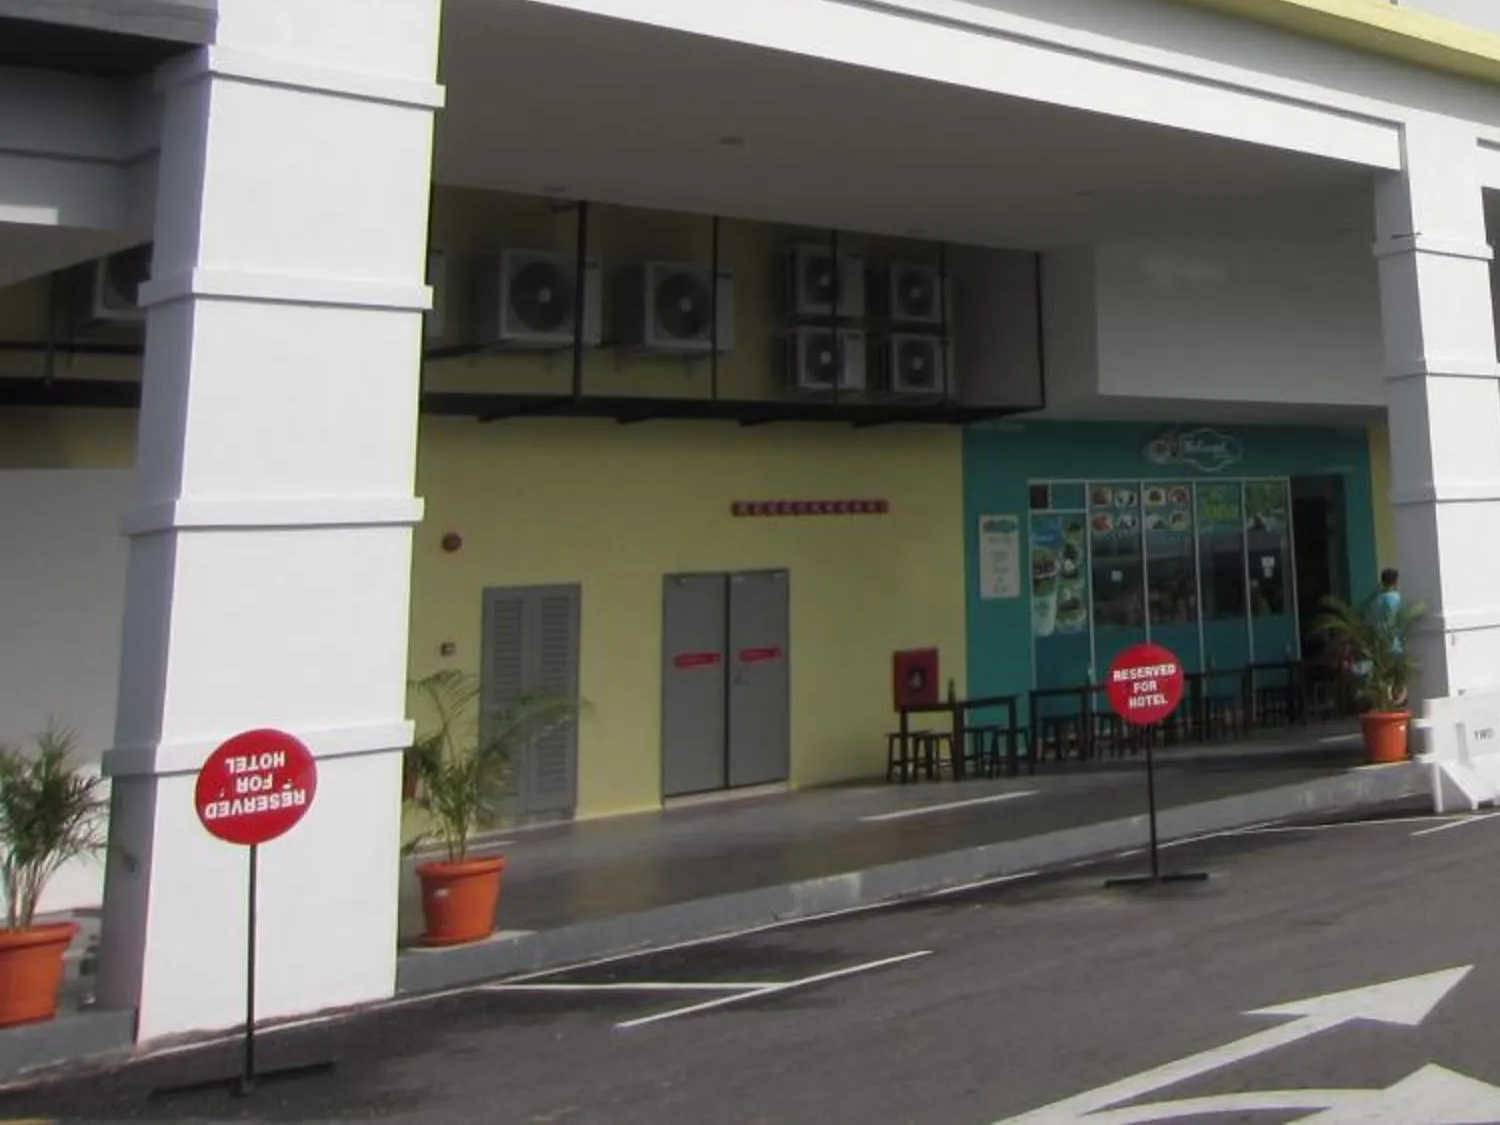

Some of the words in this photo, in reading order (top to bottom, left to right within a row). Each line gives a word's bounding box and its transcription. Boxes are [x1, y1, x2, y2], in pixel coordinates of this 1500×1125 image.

[1113, 663, 1177, 682] RESERVED
[1133, 680, 1158, 694] FOR
[1129, 693, 1168, 709] HOTEL
[224, 750, 286, 774] HOTEL
[235, 773, 273, 794] FOR
[204, 787, 306, 820] RESERVED
